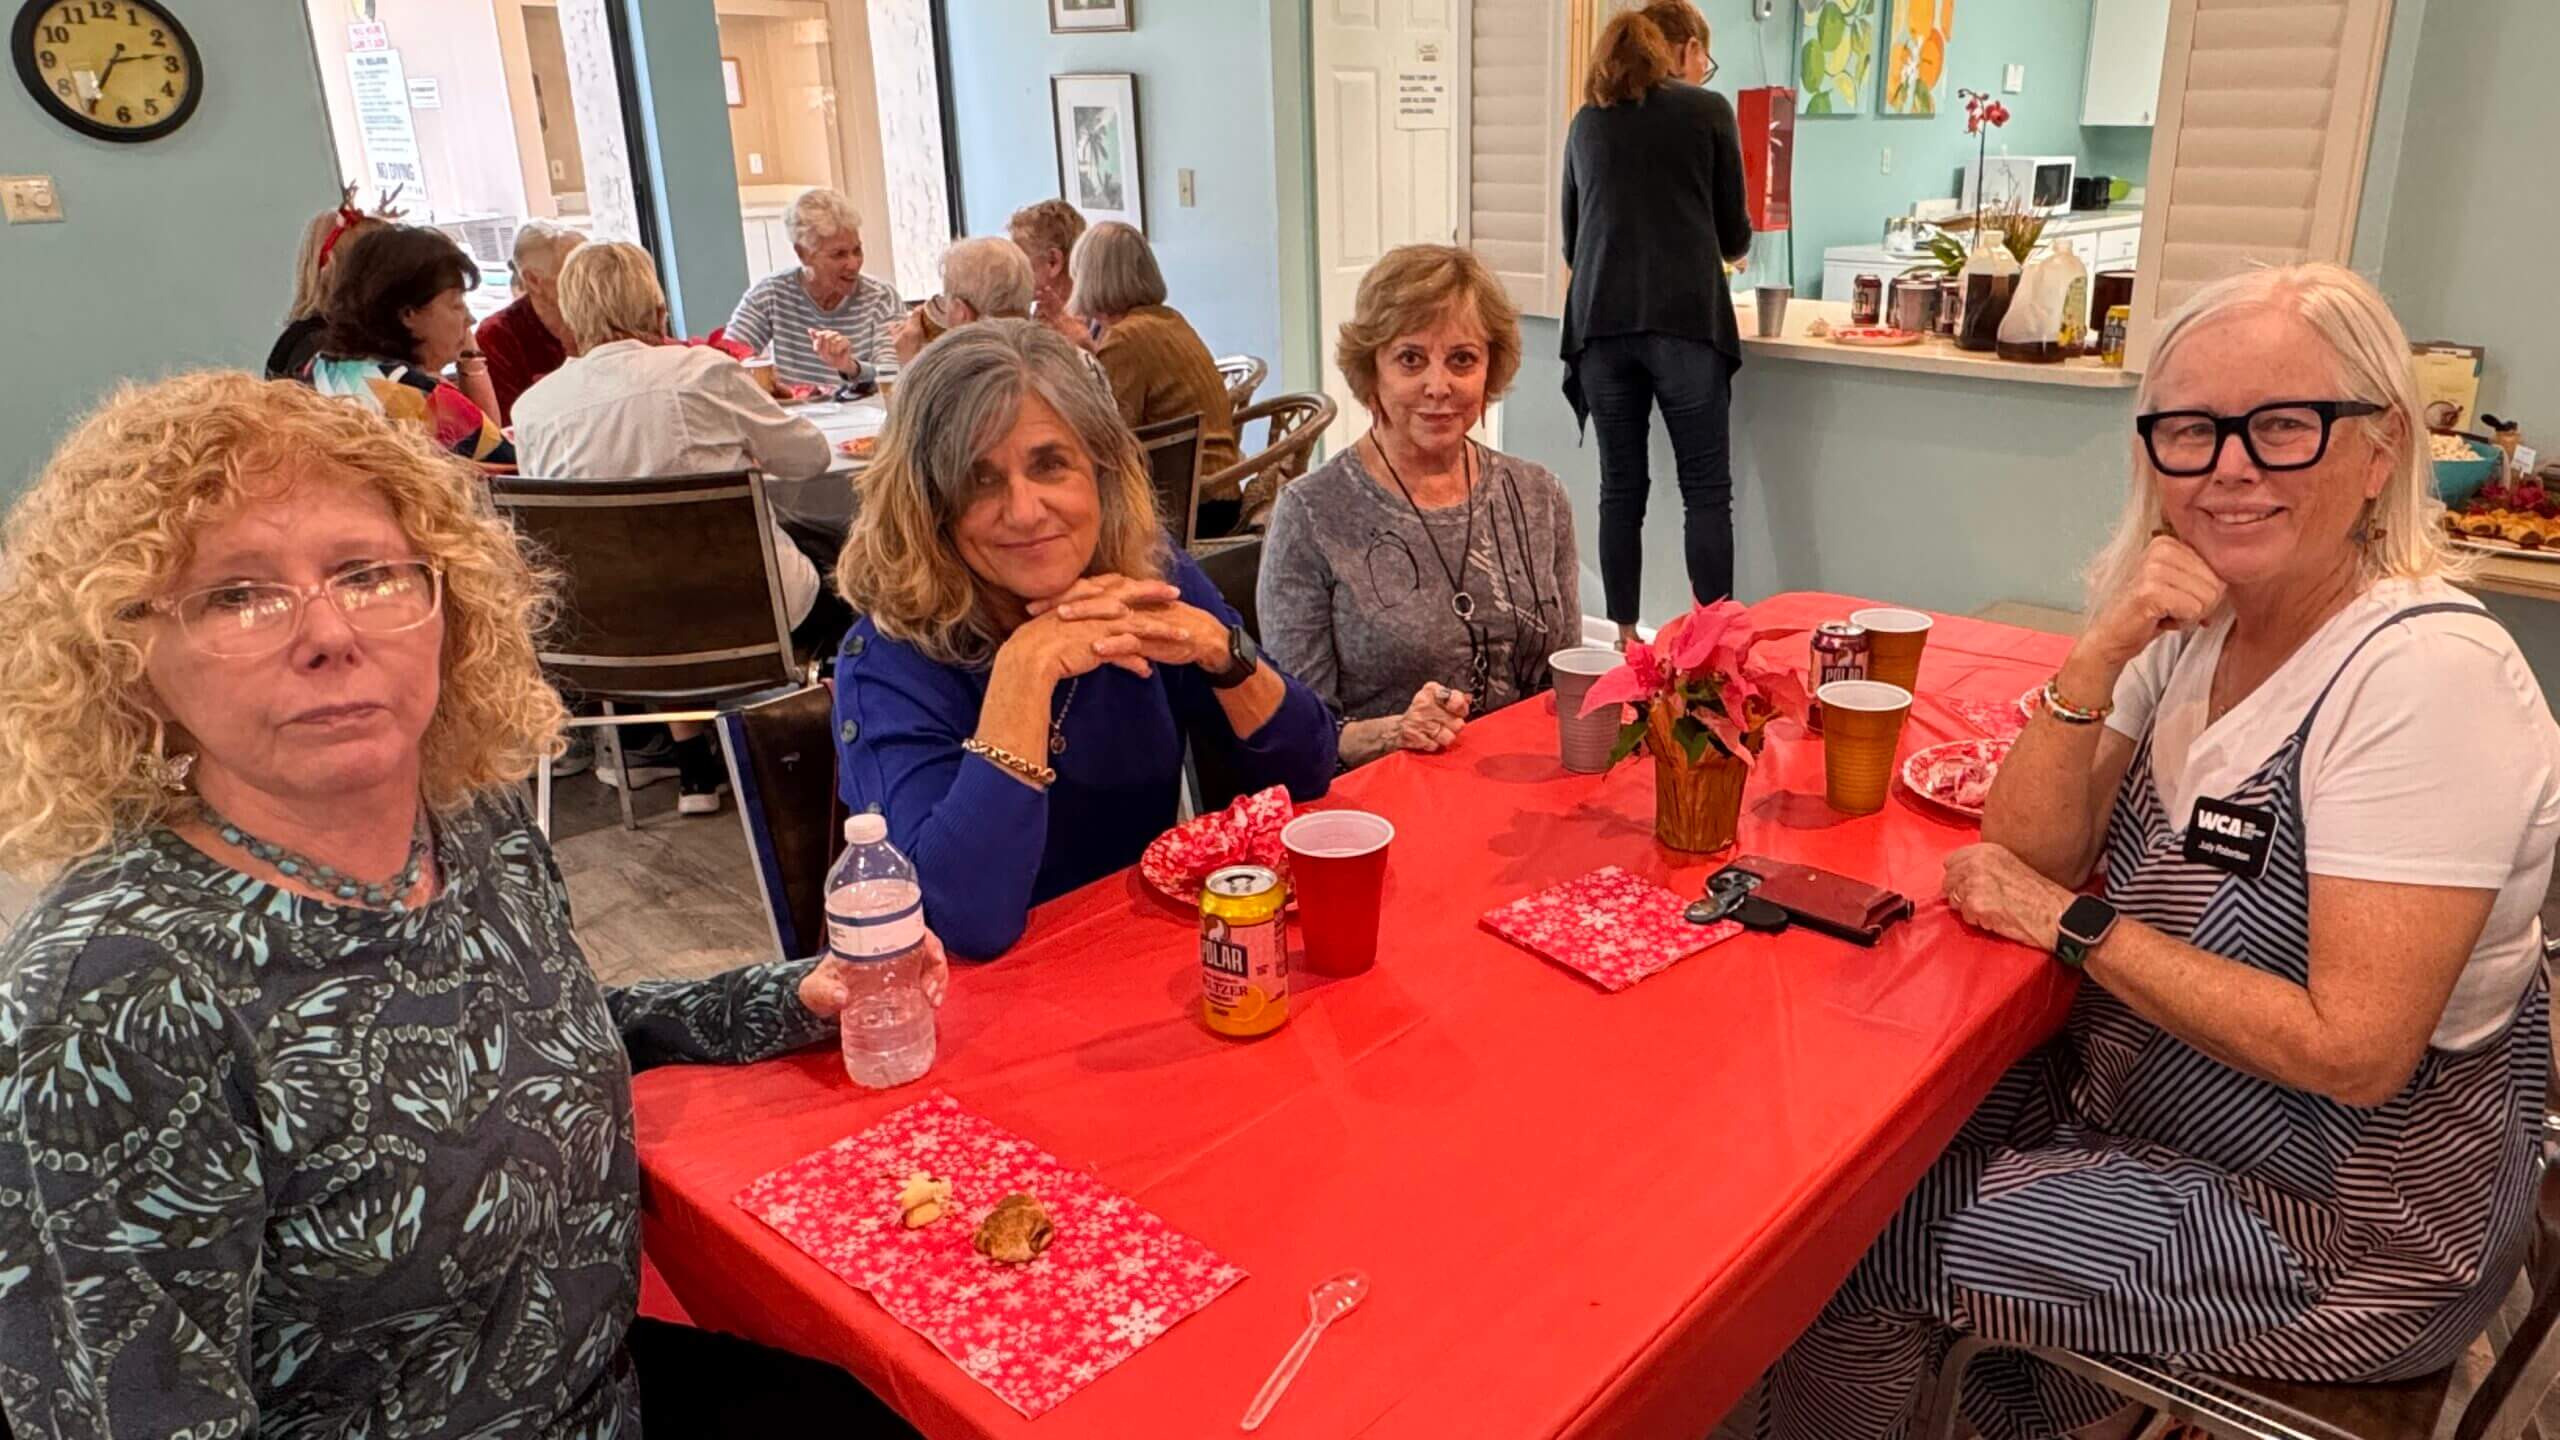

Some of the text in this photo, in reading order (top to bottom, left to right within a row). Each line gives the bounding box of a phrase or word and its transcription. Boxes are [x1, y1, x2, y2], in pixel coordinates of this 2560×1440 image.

[61, 7, 87, 25] 11
[89, 1, 117, 20] 12
[127, 9, 140, 26] 1
[43, 26, 69, 44] 10
[150, 29, 166, 47] 2
[40, 50, 56, 68] 9
[165, 55, 180, 73] 3
[56, 78, 72, 96] 8
[162, 80, 175, 97] 4
[87, 98, 98, 114] 7
[116, 106, 132, 123] 6
[144, 99, 159, 116] 5
[1826, 667, 1861, 682] POLAR
[2198, 809, 2242, 838] WCA
